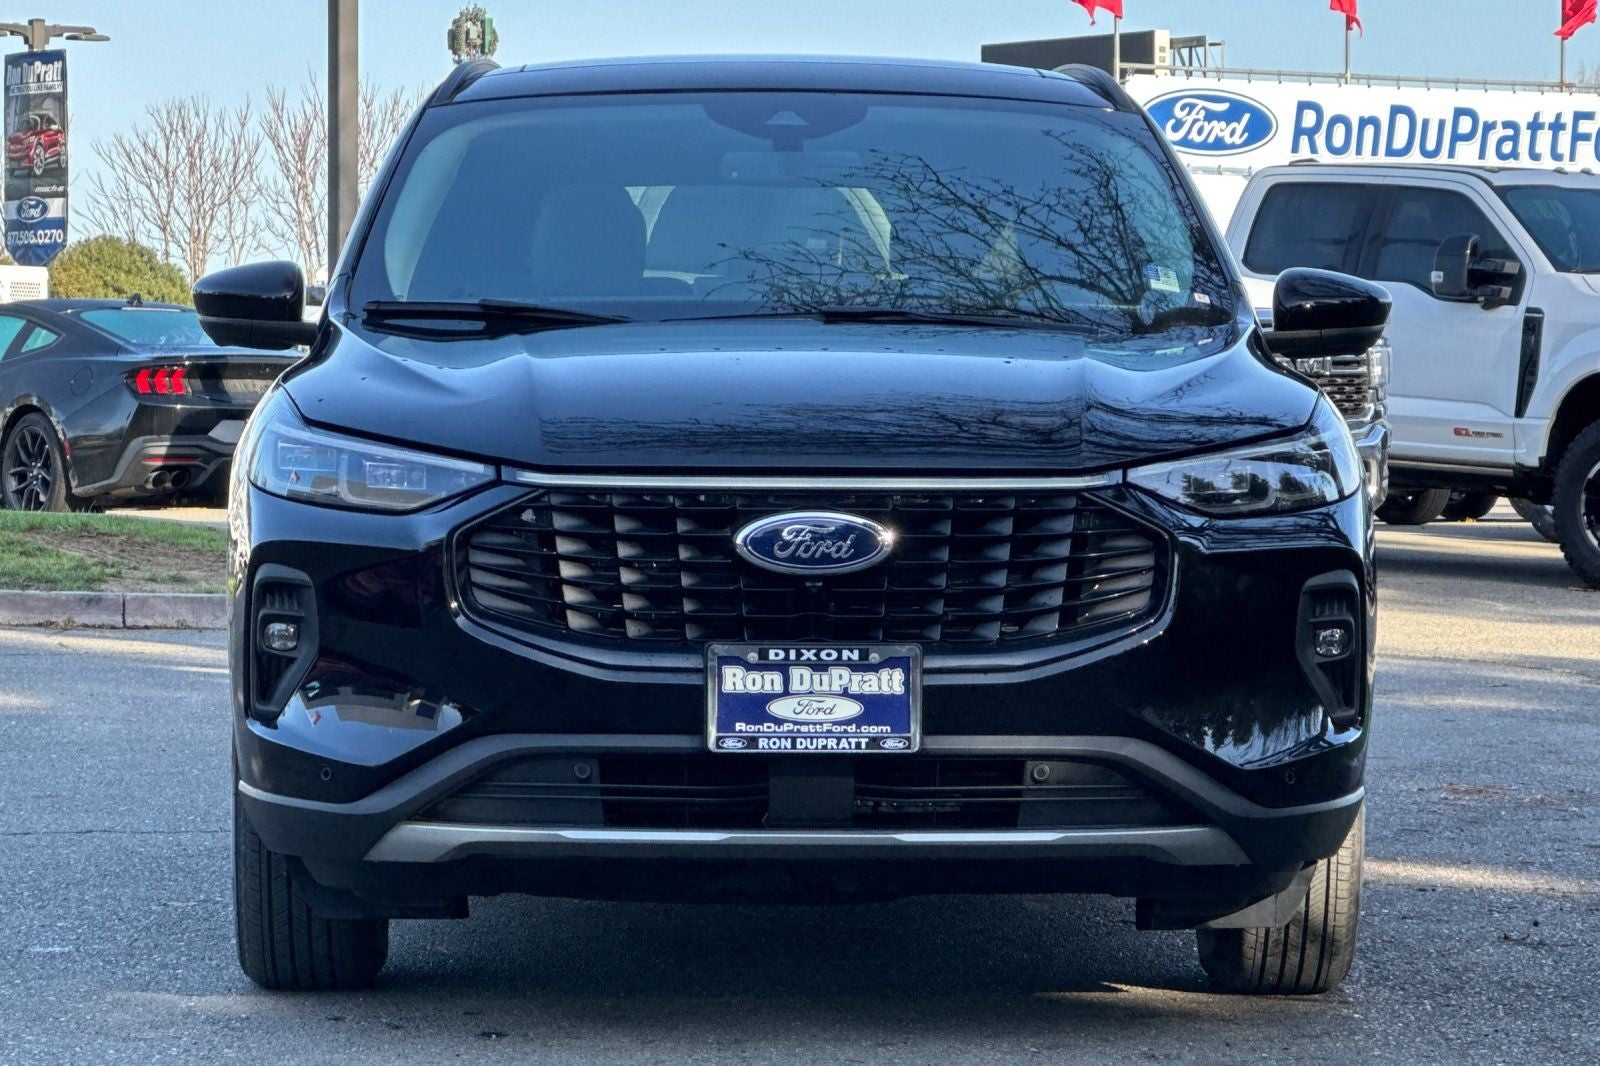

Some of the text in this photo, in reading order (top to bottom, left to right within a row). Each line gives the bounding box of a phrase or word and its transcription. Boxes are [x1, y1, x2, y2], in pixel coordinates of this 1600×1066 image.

[6, 60, 63, 85] Ron DuPratt
[1165, 97, 1251, 146] Ford
[1290, 100, 1600, 163] RonDuPrattF
[20, 200, 43, 218] Ford
[7, 229, 64, 245] 877.506.0270
[773, 524, 856, 559] Ford
[768, 649, 859, 661] DIXON
[722, 666, 904, 694] Ron DuPratt
[792, 699, 836, 716] Ford
[735, 723, 891, 733] RonDuPrattFord.com
[758, 738, 792, 750] RON
[796, 738, 868, 750] DUPRATT
